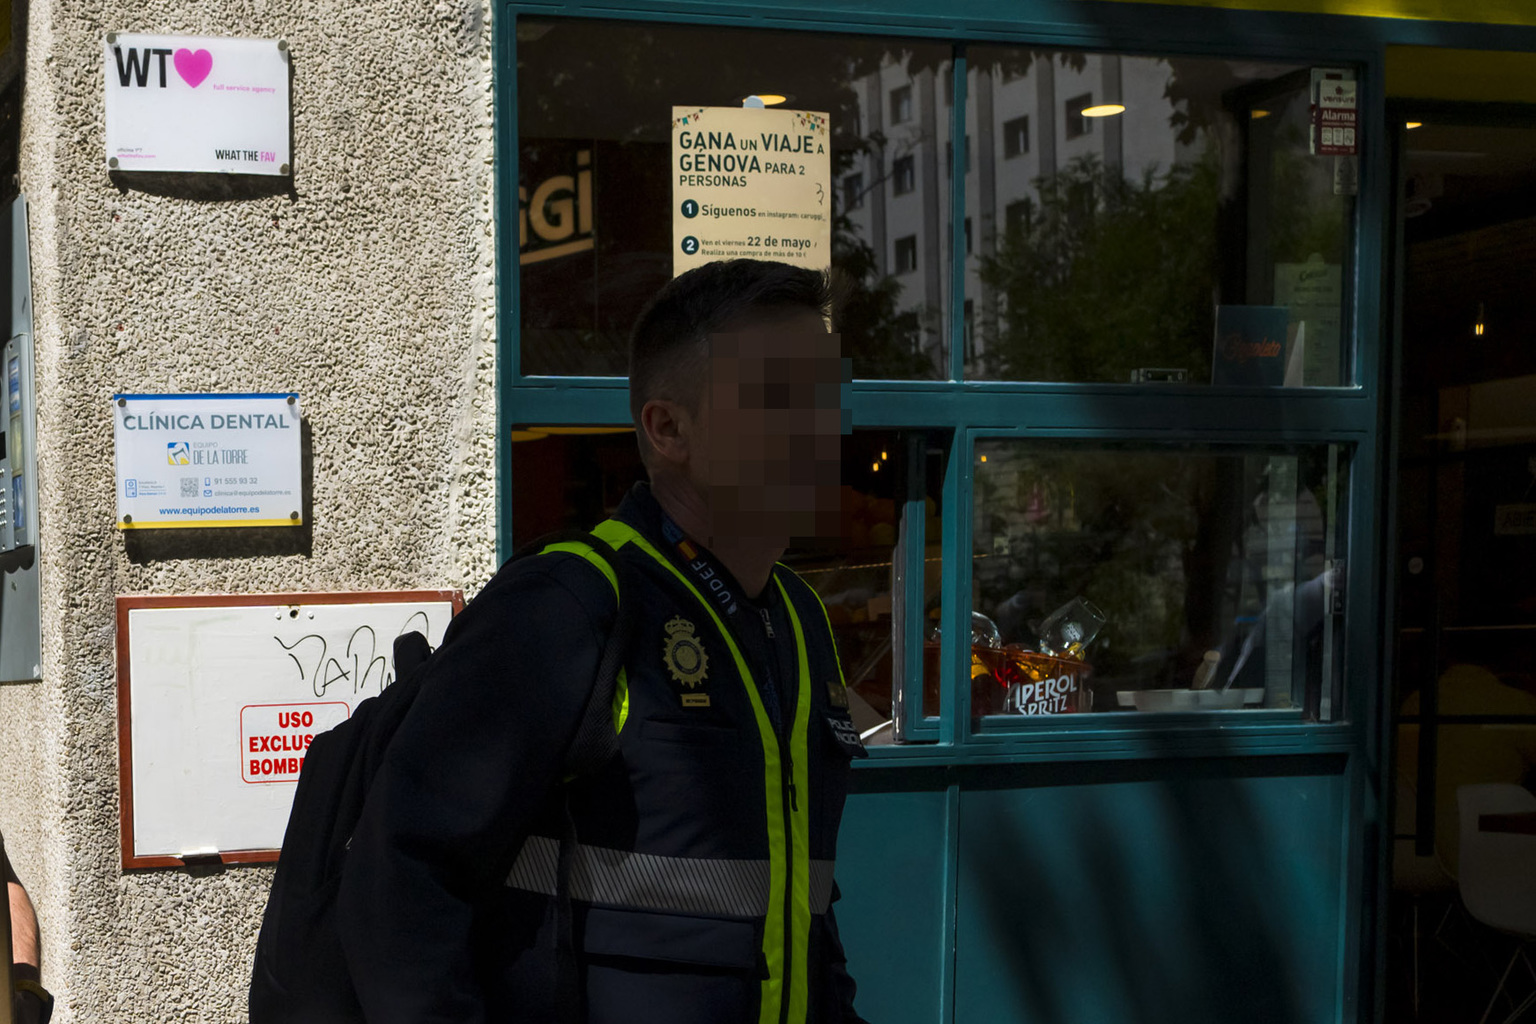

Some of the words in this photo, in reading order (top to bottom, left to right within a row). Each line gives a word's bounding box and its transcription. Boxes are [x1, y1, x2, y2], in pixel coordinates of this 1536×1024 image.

[114, 47, 173, 88] WT
[226, 84, 250, 92] service
[1321, 110, 1356, 121] Alarma
[679, 131, 736, 150] GANA
[740, 139, 757, 151] UN
[761, 133, 814, 154] VIAJE
[816, 143, 825, 155] A
[215, 149, 241, 161] WHAT
[243, 150, 259, 162] THE
[260, 151, 276, 163] FAV
[679, 148, 761, 173] GÉNOVA
[765, 162, 796, 175] PARA
[798, 165, 805, 176] 2
[679, 174, 747, 187] PERSONAS
[701, 203, 757, 219] Síguenos
[747, 236, 761, 247] 22
[764, 236, 778, 247] de
[781, 237, 811, 251] mayo
[701, 248, 725, 256] Realiza
[739, 250, 763, 258] compra
[764, 249, 771, 257] de
[123, 411, 205, 431] CLÍNICA
[210, 413, 290, 430] DENTAL
[193, 441, 219, 449] EQUIPO
[193, 449, 205, 465] DE
[207, 449, 219, 465] LA
[221, 449, 249, 465] TORRE
[238, 477, 248, 485] 93
[249, 477, 258, 485] 32
[214, 489, 292, 498] clinica@equipodelatorre.es
[159, 505, 260, 517] www.equipodelatorre.es
[690, 560, 732, 604] UDEF
[1002, 674, 1078, 712] APEROL
[278, 711, 314, 728] USO
[249, 734, 319, 753] EXCLUS
